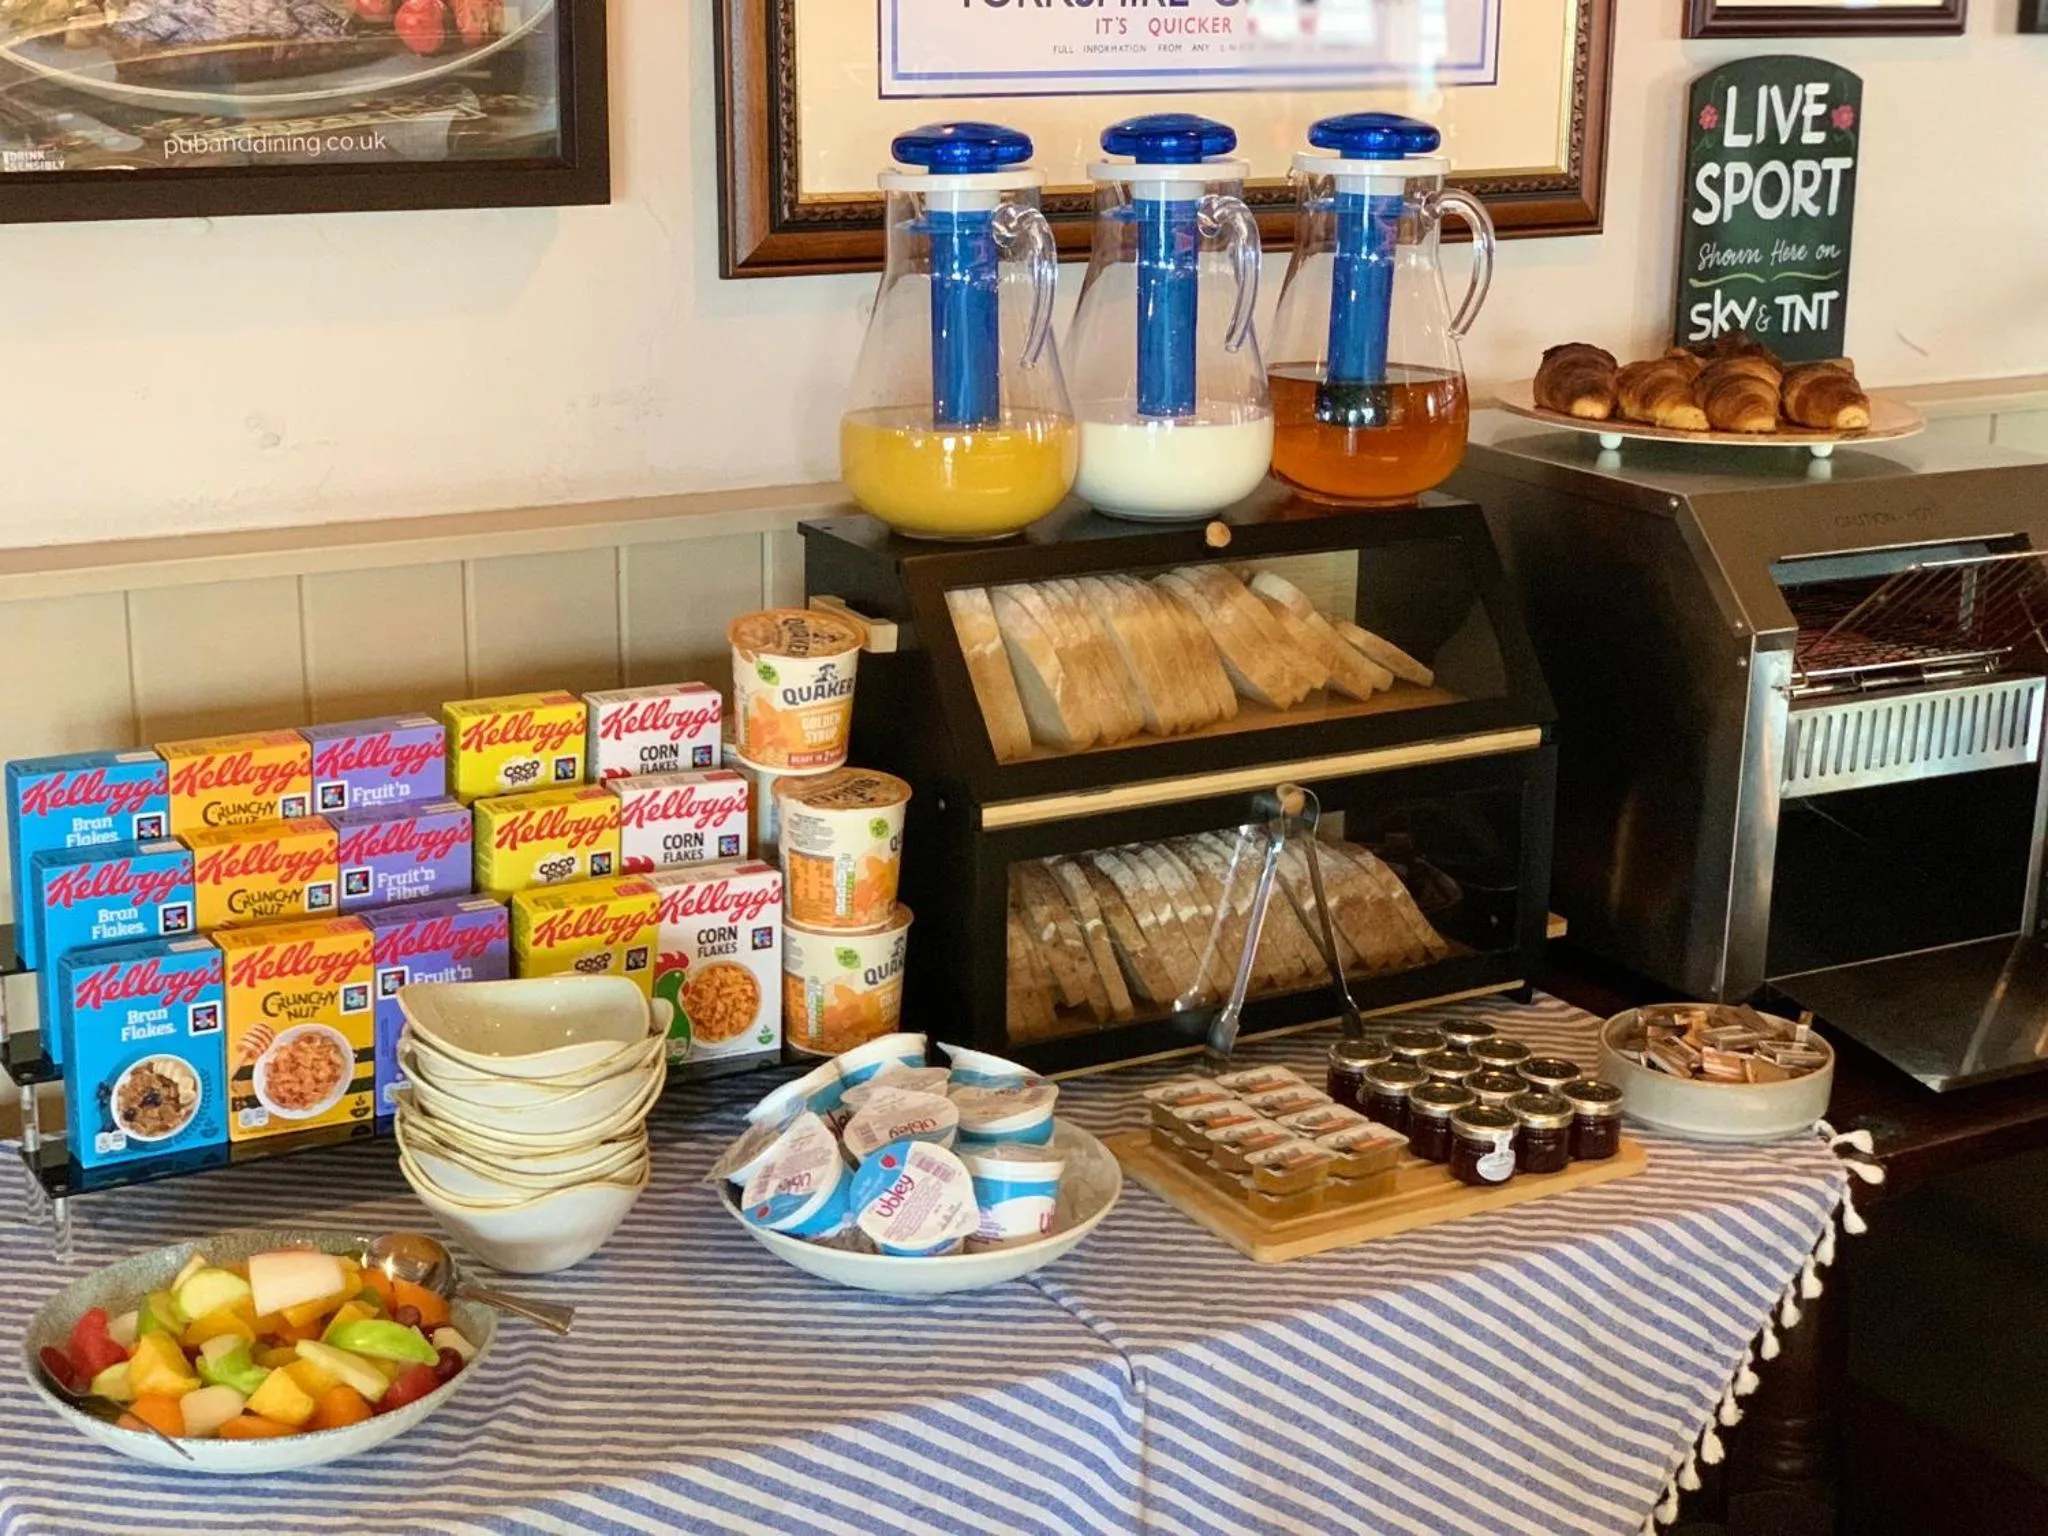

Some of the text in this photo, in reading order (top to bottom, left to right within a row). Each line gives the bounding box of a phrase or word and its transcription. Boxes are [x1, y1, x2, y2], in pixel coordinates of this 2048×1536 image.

[1096, 17, 1128, 35] IT'S
[1148, 17, 1232, 36] QUICKER
[1083, 43, 1147, 54] INFORMATION
[1158, 43, 1182, 53] FROM
[1192, 43, 1210, 52] ANY
[1722, 82, 1830, 148] LIVE
[163, 131, 387, 159] pubanddining.co.uk
[1692, 157, 1853, 226] SPORT
[1698, 238, 1840, 271] Shown Here on
[1755, 304, 1772, 332] &
[1774, 290, 1840, 333] TNT
[461, 710, 587, 753] Kellogg's
[600, 699, 722, 741] Kellogg's
[172, 751, 312, 797] Kellogg's
[315, 732, 447, 779] Kellogg's
[640, 744, 679, 762] CORN
[640, 759, 679, 775] FLAKES
[21, 768, 170, 816] Kellogg's
[622, 786, 750, 829] Kellogg's
[73, 816, 113, 832] Bran
[202, 801, 278, 826] CRUNCHY
[496, 804, 622, 851] Kellogg's
[340, 817, 473, 864] Kellogg's
[663, 832, 704, 850] CORN
[663, 848, 704, 863] FLAKES
[46, 859, 195, 907] Kellogg's
[196, 840, 341, 885] Kellogg's
[98, 907, 139, 922] Bran
[228, 887, 304, 914] CRUNCHY
[252, 903, 286, 917] NUT
[659, 879, 784, 925] Kellogg's
[373, 914, 508, 965] Kellogg's
[532, 901, 662, 948] Kellogg's
[697, 926, 738, 945] CORN
[231, 940, 376, 988] Kellogg's
[697, 942, 738, 958] FLAKES
[75, 957, 224, 1010] Kellogg's
[261, 990, 339, 1018] CRUNCHY
[127, 1008, 169, 1025] Bran
[287, 1005, 320, 1019] NUT
[876, 1173, 916, 1218] Ubley
